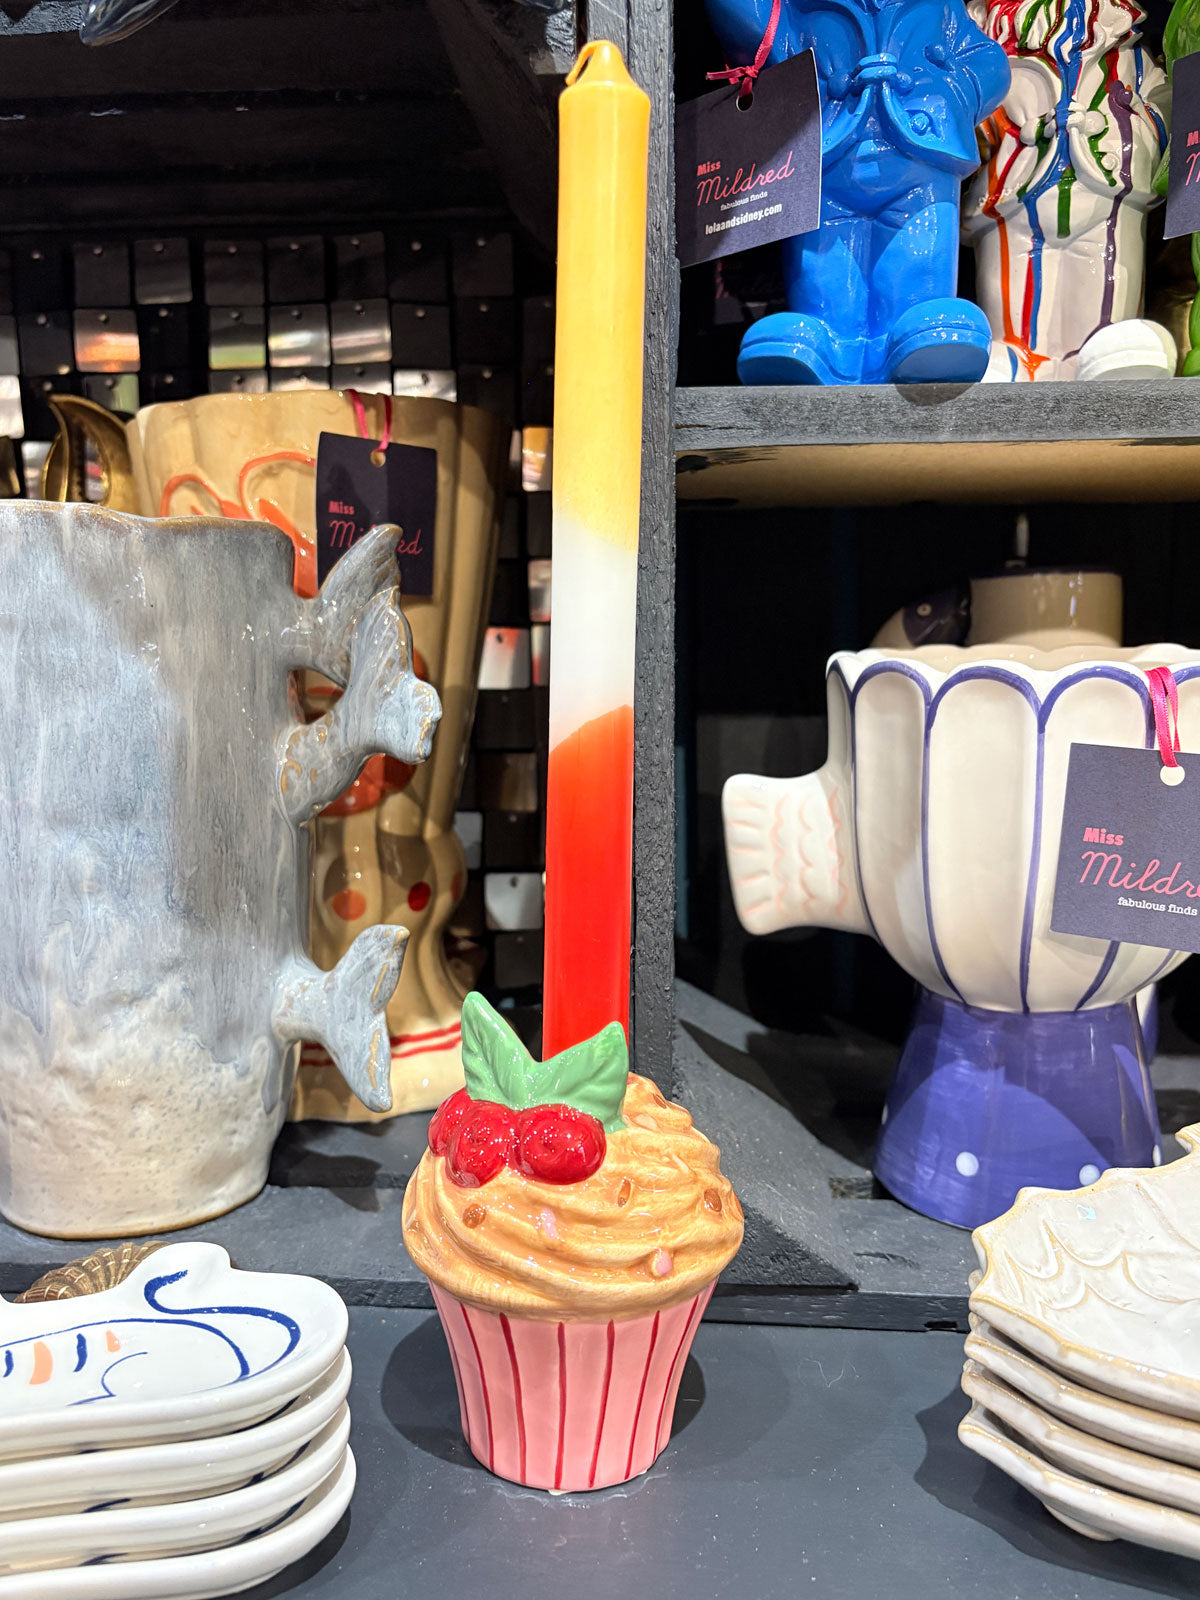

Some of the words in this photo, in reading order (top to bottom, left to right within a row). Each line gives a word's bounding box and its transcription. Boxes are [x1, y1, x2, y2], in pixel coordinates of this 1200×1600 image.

[696, 150, 795, 207] Mildred
[697, 161, 721, 177] Miss
[720, 197, 750, 211] fabulous
[750, 191, 768, 202] finds
[705, 203, 782, 235] lolaandsidney.com
[328, 500, 355, 516] Miss
[1082, 827, 1124, 846] Miss
[1079, 851, 1200, 898] Mildr
[1117, 896, 1166, 912] fabulous
[1167, 904, 1198, 917] finds
